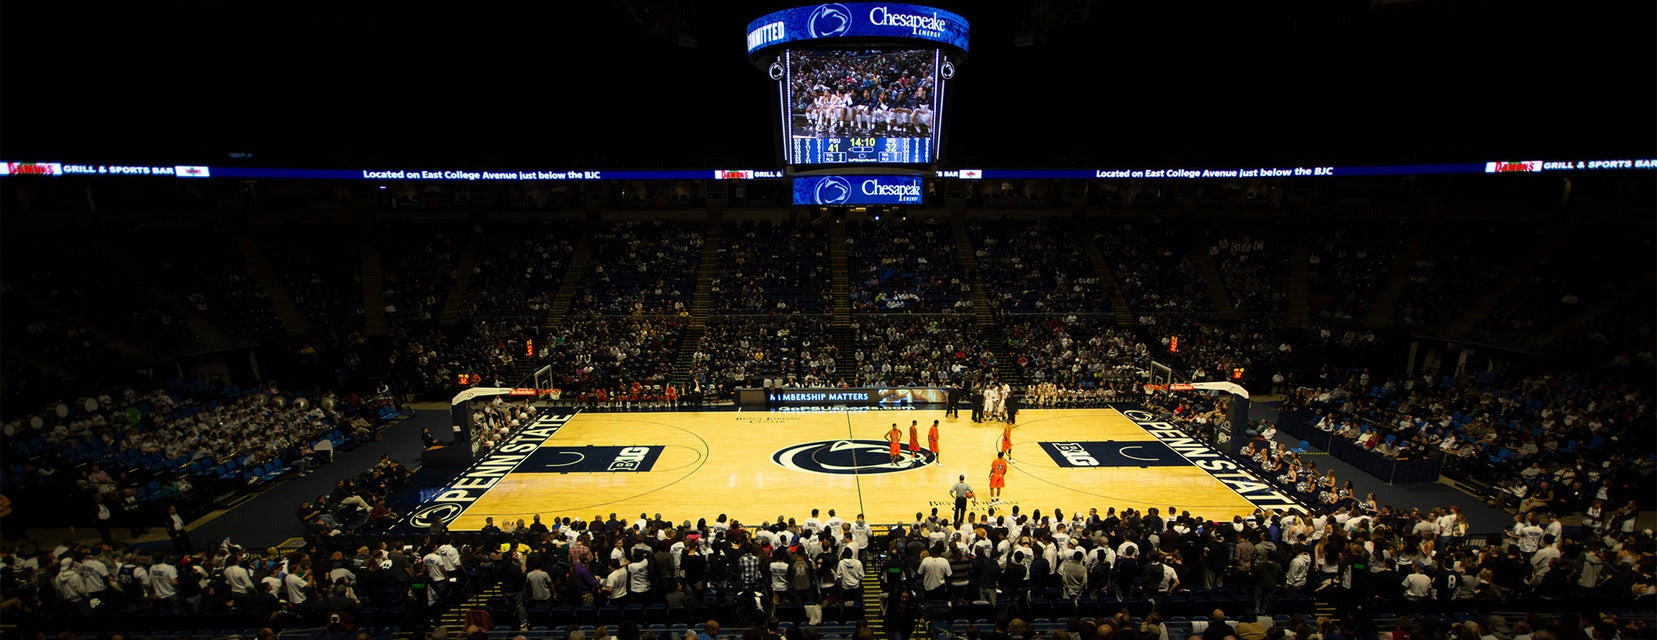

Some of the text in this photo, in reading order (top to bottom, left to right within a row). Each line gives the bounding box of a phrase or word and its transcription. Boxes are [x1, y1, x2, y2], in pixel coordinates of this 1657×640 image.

[869, 7, 946, 35] Chesapeake
[917, 30, 942, 38] ENERGY
[850, 137, 876, 147] 14:10
[827, 143, 840, 153] 41
[885, 143, 897, 153] 32
[1543, 159, 1657, 170] GRILL & SPORTS BAR
[63, 165, 175, 175] GRILL & SPORTS BAR
[363, 170, 601, 180] Located on East College Avenue just below the BJC
[754, 170, 776, 178] GRILL
[943, 170, 959, 178] BAR
[1096, 169, 1130, 178] Located
[1145, 169, 1165, 178] East
[1166, 169, 1201, 178] College
[1202, 169, 1237, 178] Avenue
[1239, 168, 1258, 178] just
[1259, 167, 1292, 177] below
[1294, 167, 1312, 176] the
[1314, 166, 1334, 176] BJC
[861, 179, 920, 202] Chesapeake
[828, 392, 869, 401] MATTERS
[500, 412, 574, 454] STATE
[1144, 421, 1220, 458] PENN
[434, 451, 518, 503] PENN
[1195, 459, 1310, 516] STATE
